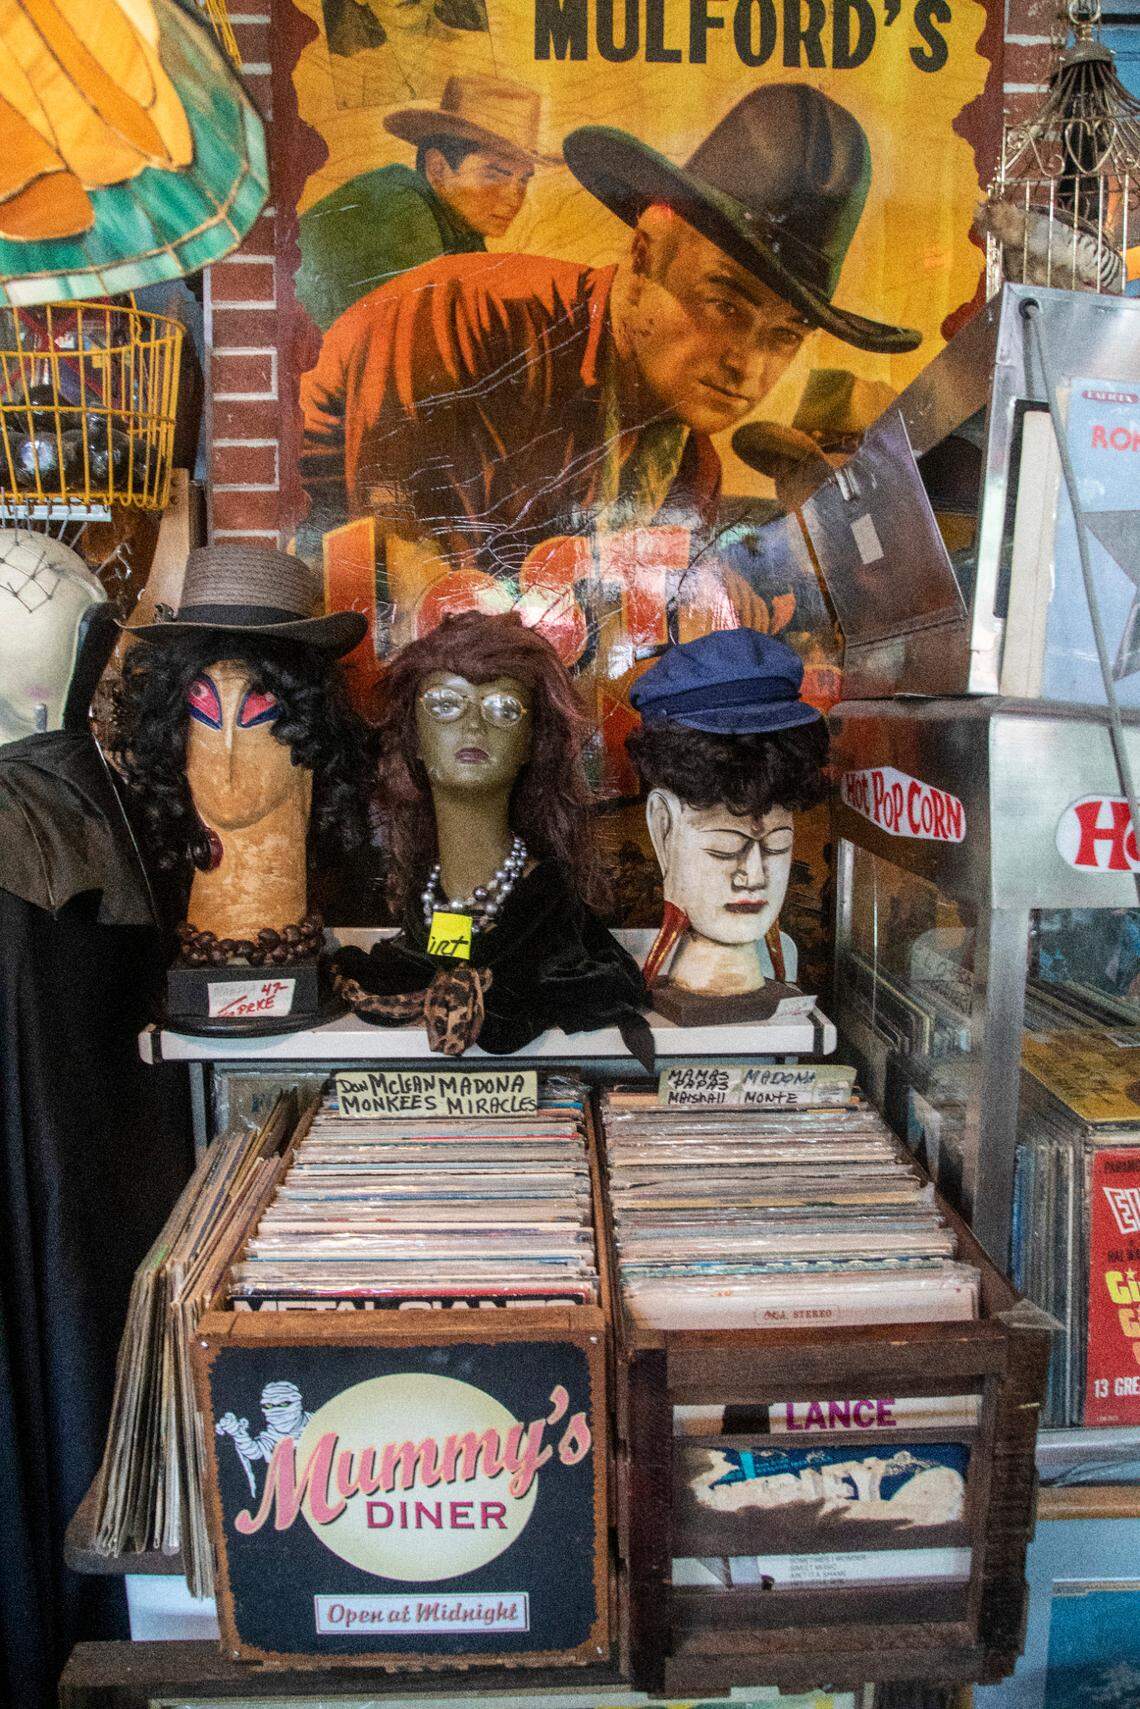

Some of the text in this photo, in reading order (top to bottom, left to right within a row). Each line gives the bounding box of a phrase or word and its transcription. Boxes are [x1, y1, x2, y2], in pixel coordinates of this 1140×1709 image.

[533, 0, 952, 73] MULFORD'S
[439, 1074, 525, 1098] MADONA
[341, 1095, 538, 1115] MONKEES MIRACLES
[1094, 1379, 1110, 1399] 13
[785, 1398, 897, 1431] LANCE
[234, 1384, 592, 1535] Mummy's
[366, 1500, 509, 1530] DINER
[327, 1600, 519, 1628] Open at Midnight
